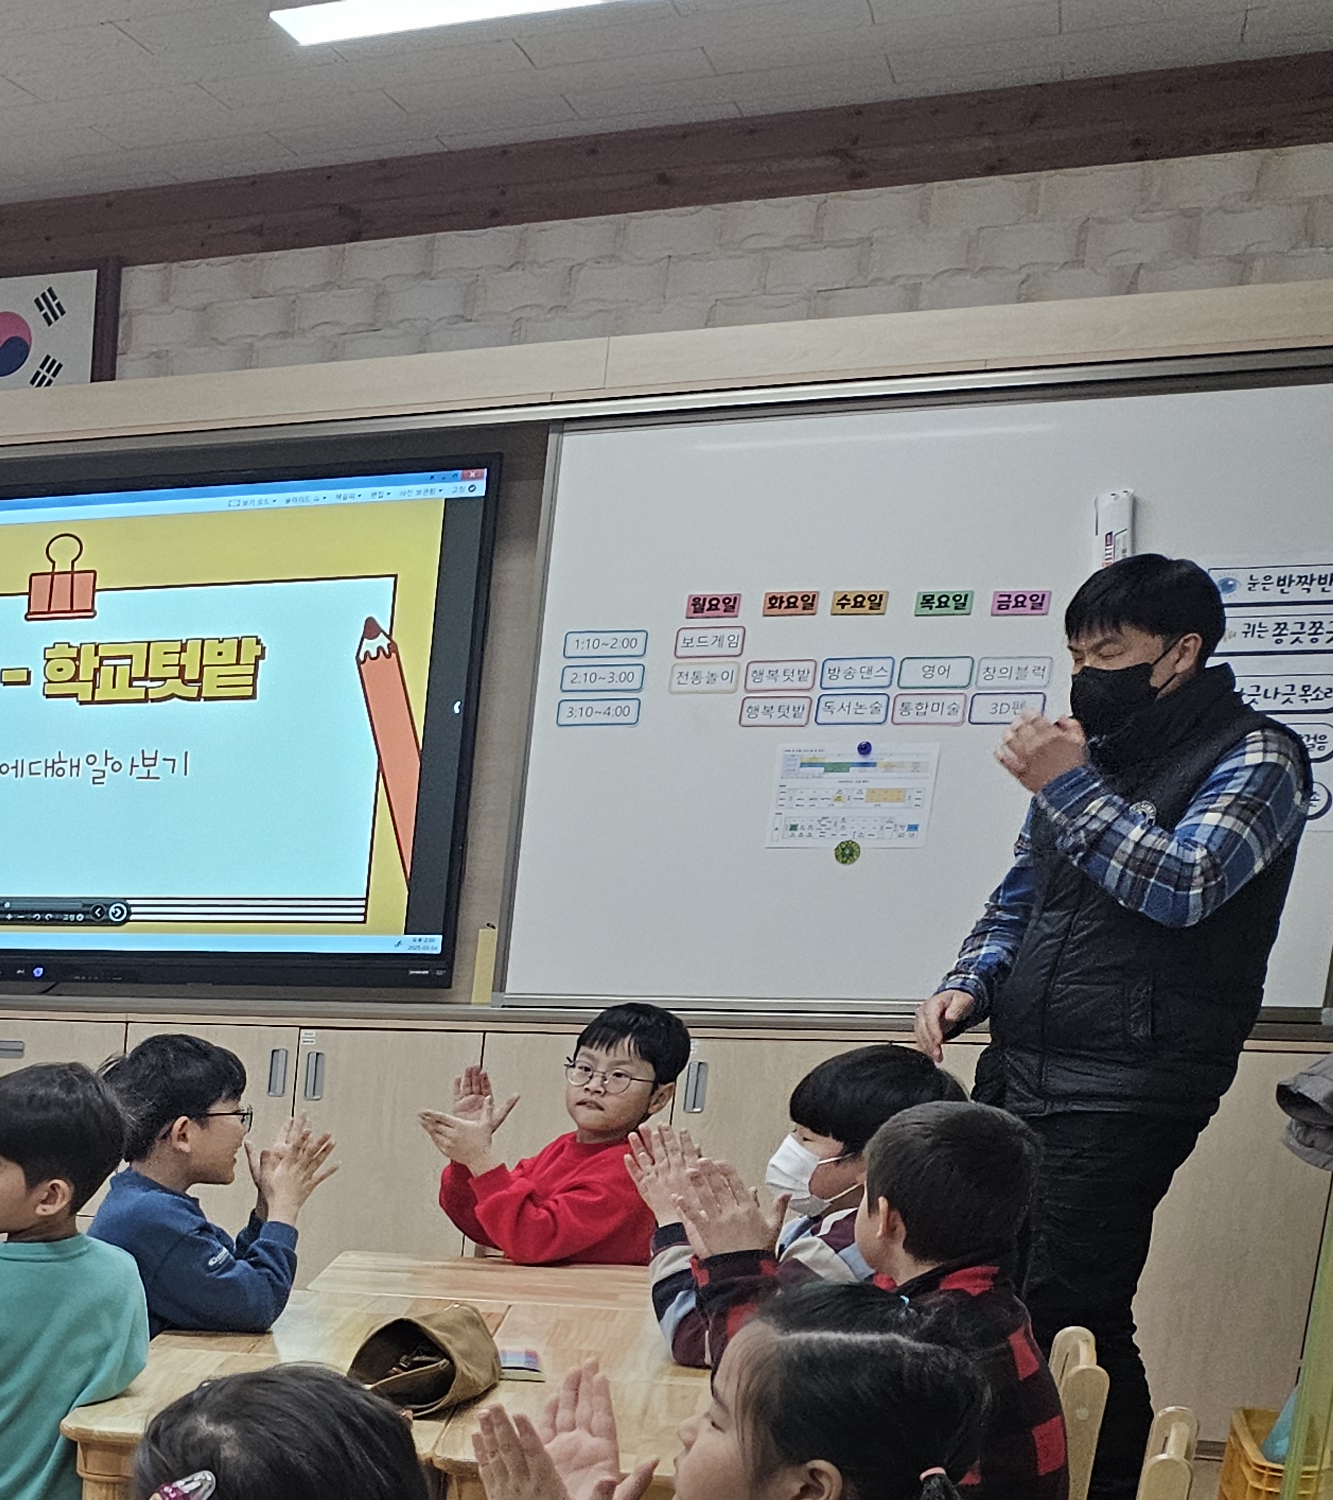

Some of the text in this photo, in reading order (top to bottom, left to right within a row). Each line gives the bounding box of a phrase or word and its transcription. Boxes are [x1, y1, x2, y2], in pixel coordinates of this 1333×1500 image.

[1247, 574, 1274, 591] 눈은
[691, 596, 737, 613] 월요일
[767, 594, 817, 611] 화요일
[836, 593, 883, 609] 수요일
[920, 593, 969, 610] 목요일
[996, 593, 1046, 610] 금요일
[1241, 622, 1269, 638] 귀는
[575, 637, 638, 650] 1:10~2:00
[682, 634, 740, 649] 보드게임
[43, 636, 265, 705] 학교텃밭
[570, 671, 634, 684] 2:10~3:00
[676, 669, 734, 686] 전통놀이
[751, 668, 811, 683] 행복텃밭
[827, 665, 889, 680] 방송댄스
[921, 664, 951, 679] 영어
[566, 705, 631, 718] 3:10~4:00
[746, 704, 806, 719] 행복텃밭
[822, 701, 883, 715] 독서논술
[898, 701, 961, 716] 통합미술
